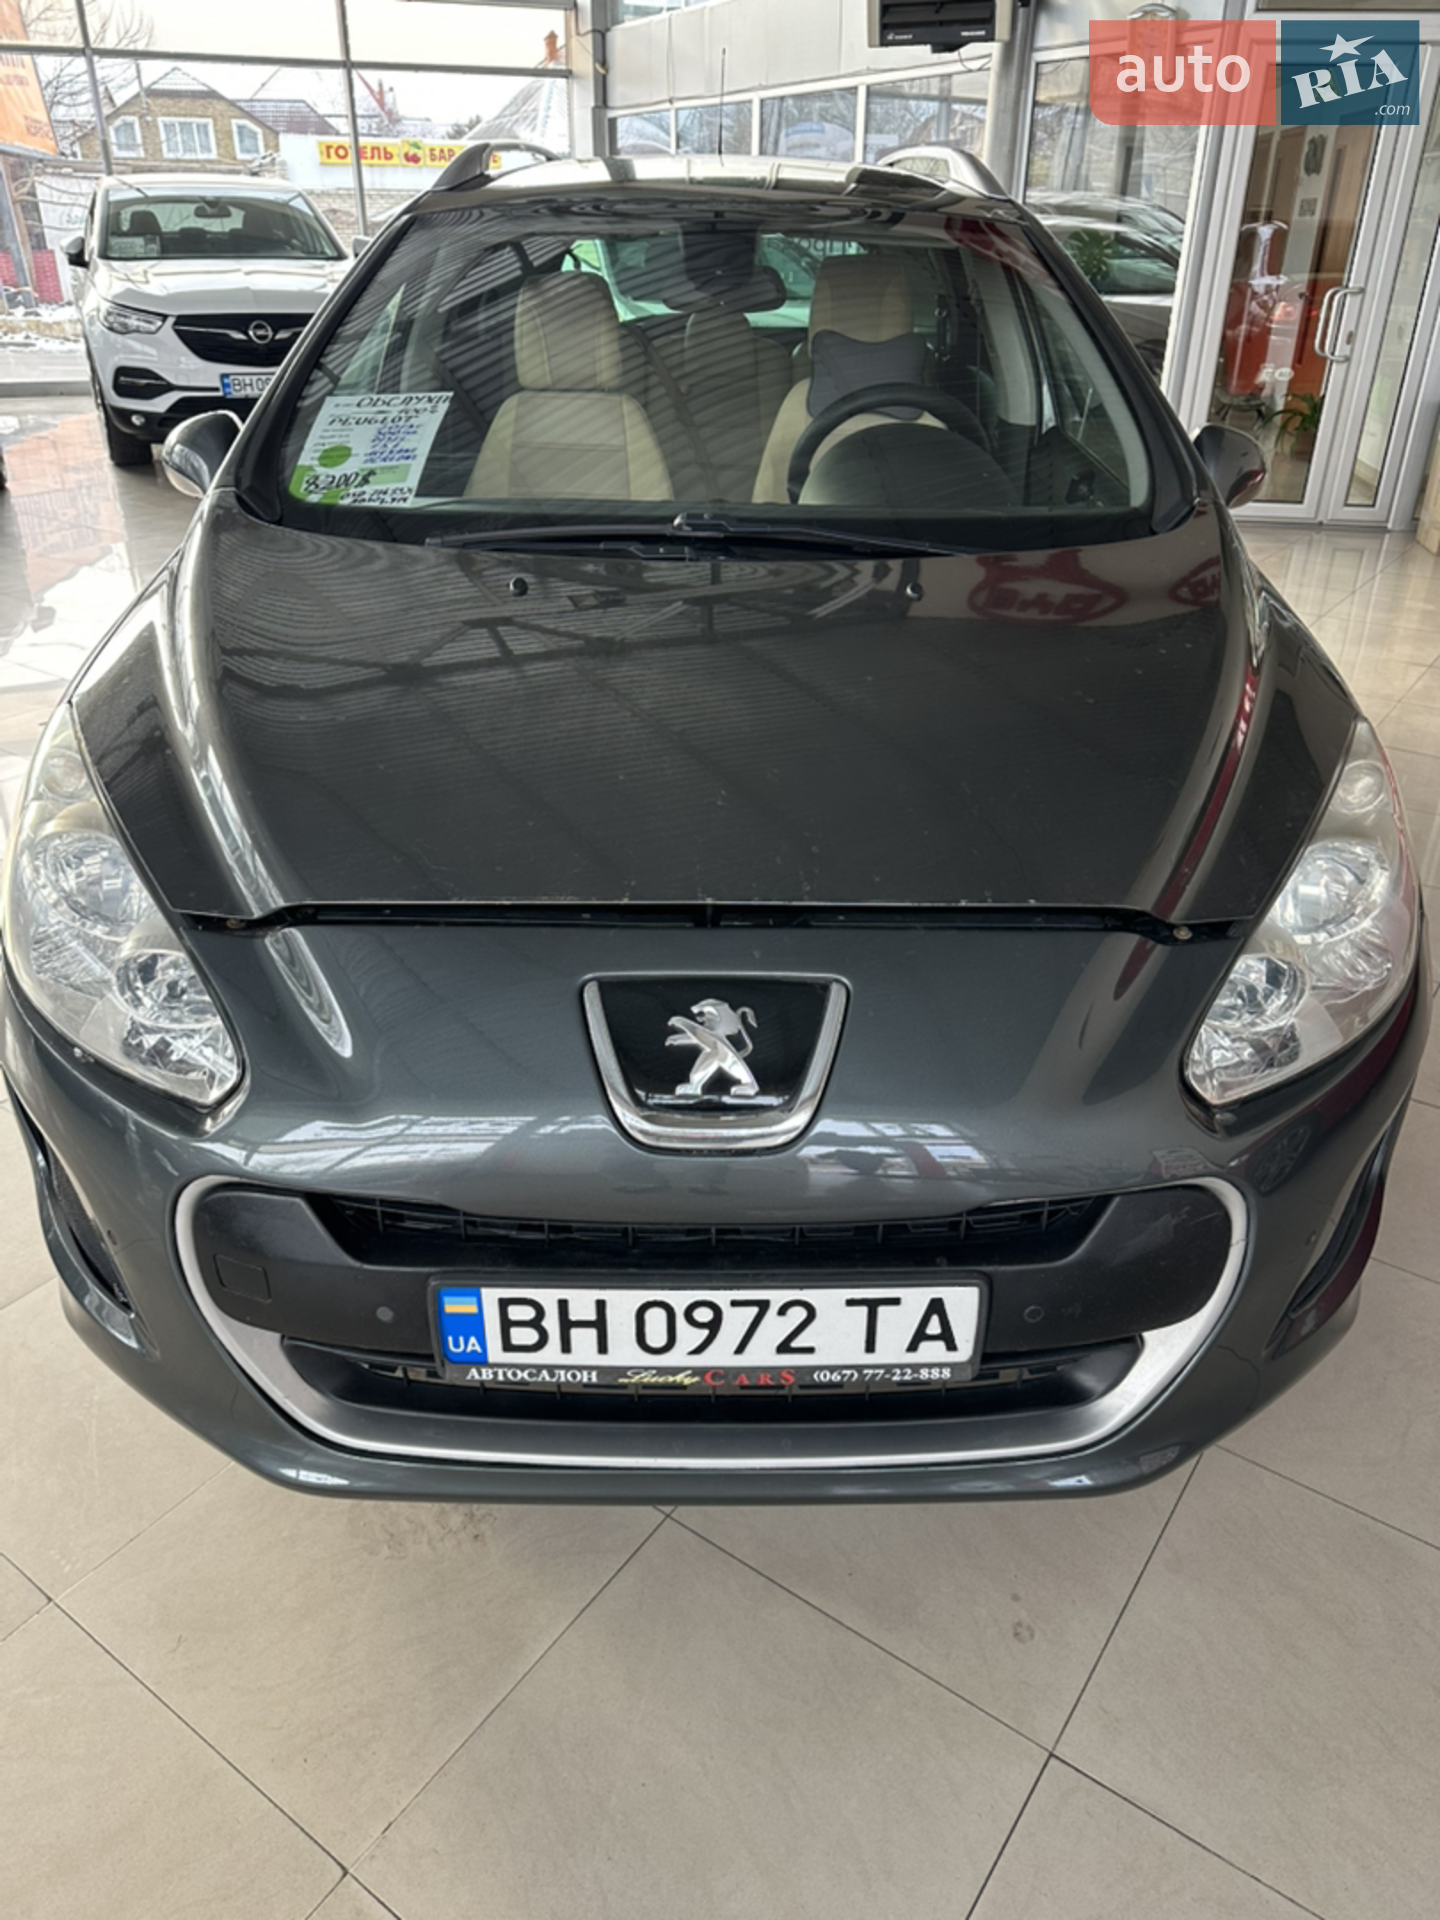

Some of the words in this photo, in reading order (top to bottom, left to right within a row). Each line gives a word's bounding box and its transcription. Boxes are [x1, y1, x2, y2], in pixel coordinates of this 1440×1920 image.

[324, 144, 394, 161] ГОЕЛЬ
[498, 1297, 609, 1355] BH
[634, 1299, 817, 1356] 0972
[845, 1296, 959, 1354] TA
[448, 1336, 483, 1354] UA
[465, 1367, 598, 1383] АВТОСАЛОН
[618, 1368, 701, 1386] Lucky
[813, 1369, 858, 1382] (067)
[863, 1367, 952, 1381] 77-22-888
